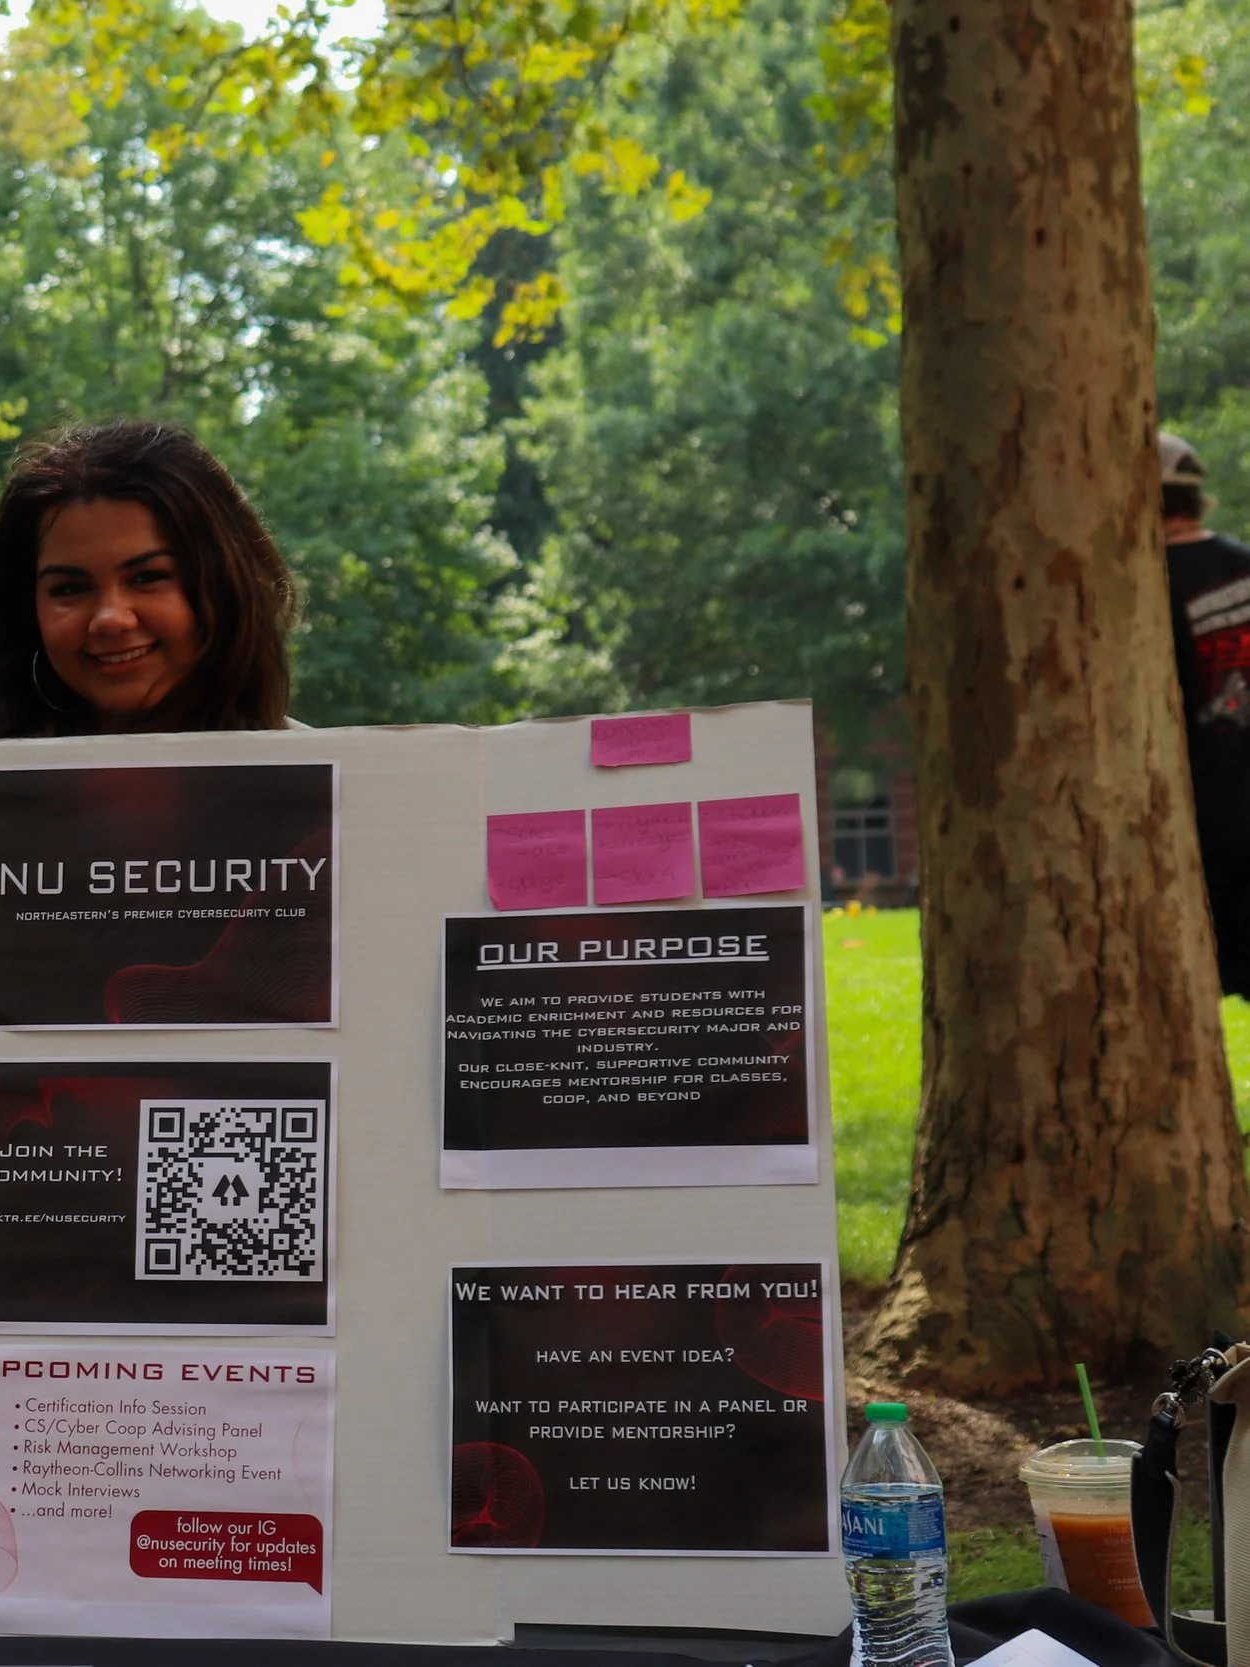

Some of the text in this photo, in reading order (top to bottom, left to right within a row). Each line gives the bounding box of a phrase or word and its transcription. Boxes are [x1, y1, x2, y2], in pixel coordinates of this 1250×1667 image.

[1, 858, 326, 895] NU SECURITY
[17, 908, 305, 920] NORTHEASTERN'S PREMIER CYBERSECURITY CLUB
[480, 935, 768, 964] OUR PURPOSE
[481, 998, 503, 1007] WE
[510, 998, 535, 1006] AIM
[568, 994, 634, 1004] PROVIDE
[641, 991, 721, 1002] STUDENTS
[446, 1004, 802, 1024] ACADEMIC ENRICHMENT AND RESOURCES FOR
[448, 1021, 801, 1041] NAVIGATING THE CYBERSECURITY MAJOR AND
[578, 1043, 658, 1053] INDUSTRY.
[459, 1056, 789, 1073] OUR CLOSE-KNIT, SUPPORTIVE COMMUNITY
[461, 1073, 787, 1089] ENCOURAGES MENTORSHIP FOR CLASSES,
[543, 1092, 700, 1104] COOP, AND BEYOND
[0, 1144, 107, 1157] JOIN THE
[456, 1279, 818, 1301] WE WANT TO HEAR FROM YOU!
[537, 1348, 734, 1362] HAVE AN EVENT IDEA?
[182, 1364, 314, 1383] EVENTS
[26, 1397, 206, 1415] Certification Info Session
[476, 1400, 807, 1413] WANT TO PARTICIPATE IN A PANEL OR
[25, 1419, 262, 1441] CS/Cyber Coop Advising Panel
[530, 1424, 735, 1438] PROVIDE MENTORSHIP?
[24, 1439, 237, 1462] Risk Management Workshop
[24, 1460, 281, 1483] Raytheon-Collins Networking Event
[22, 1481, 140, 1498] Mock Interviews
[570, 1475, 695, 1490] LET US KNOW!
[71, 1504, 111, 1518] more!
[177, 1517, 276, 1535] follow our IG
[137, 1535, 316, 1557] @nusecurity for updates
[159, 1556, 291, 1574] on meeting times!
